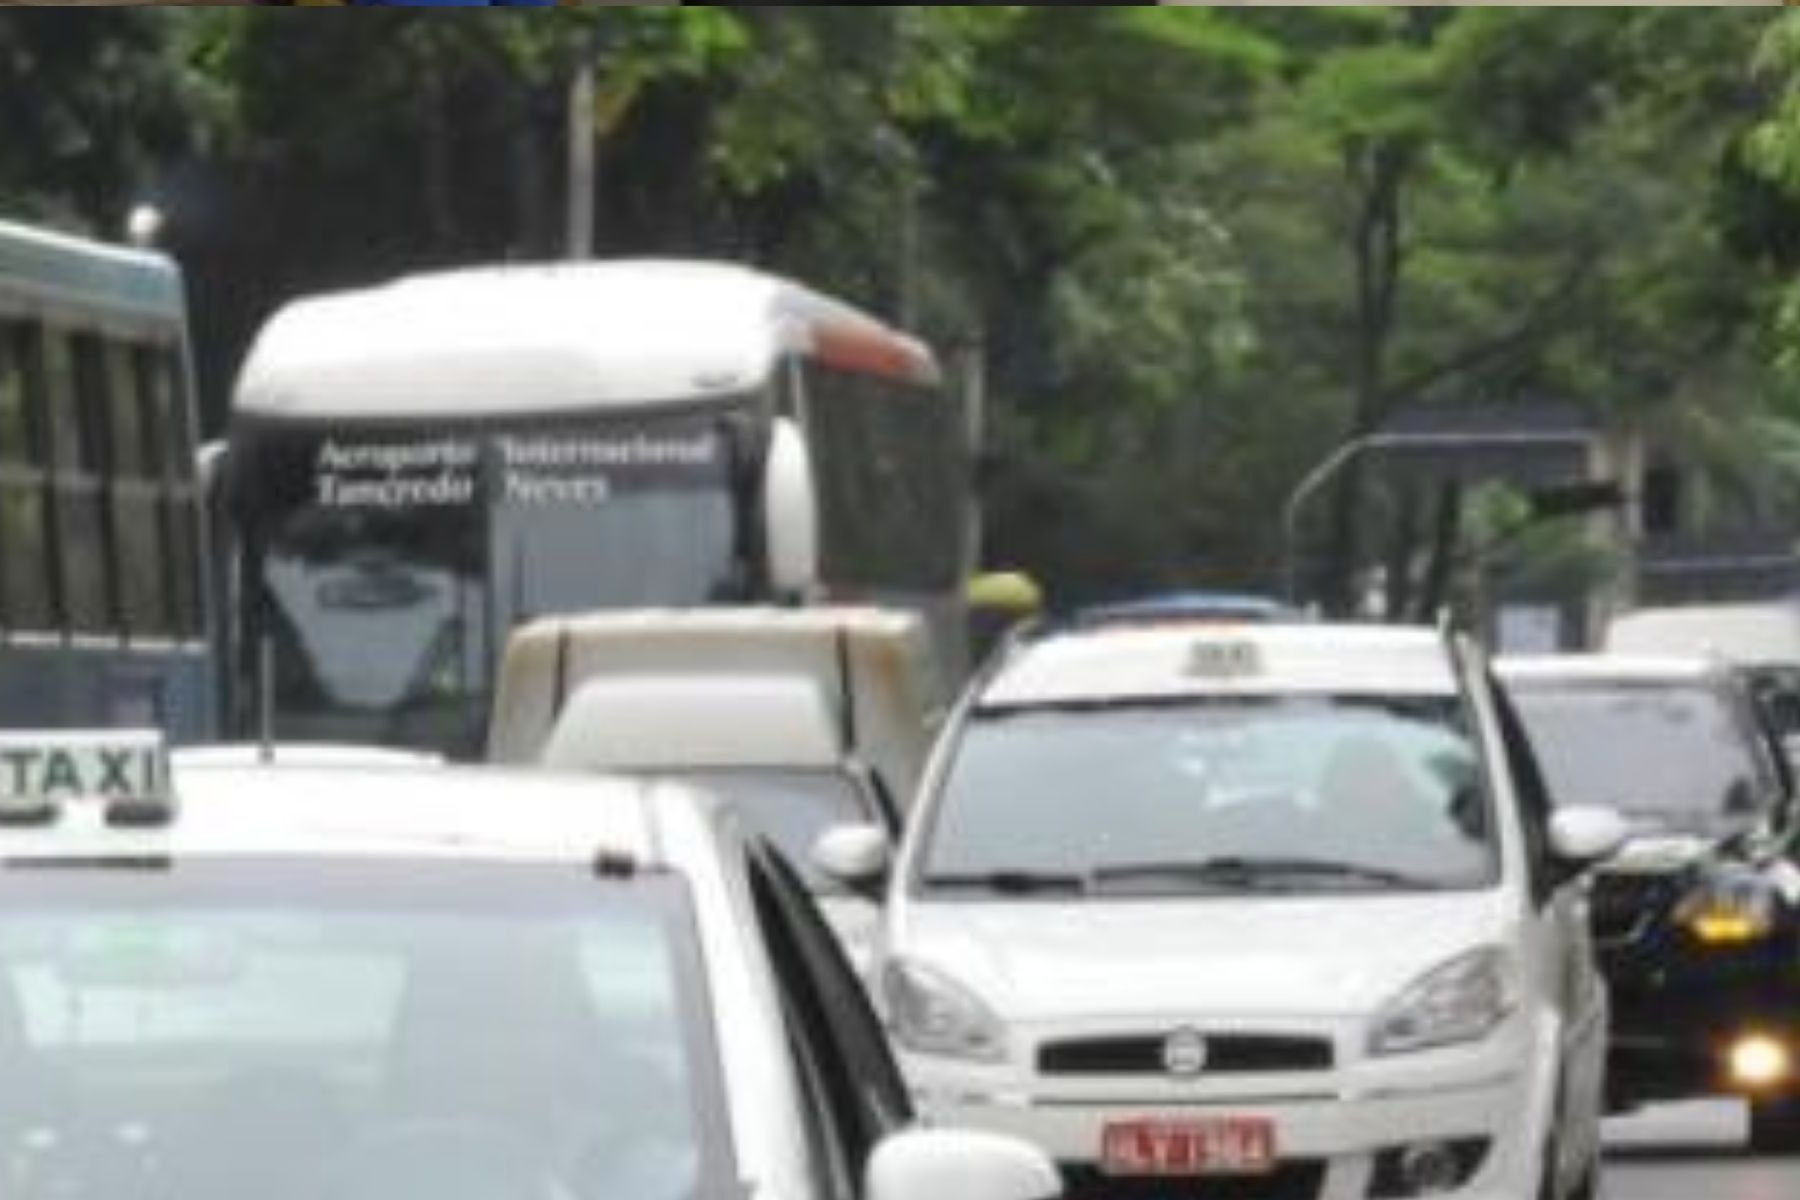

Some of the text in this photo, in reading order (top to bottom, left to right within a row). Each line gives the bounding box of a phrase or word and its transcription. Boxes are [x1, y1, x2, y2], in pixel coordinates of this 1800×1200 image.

[318, 473, 610, 506] Tancredo Neves
[0, 747, 156, 796] TAXI
